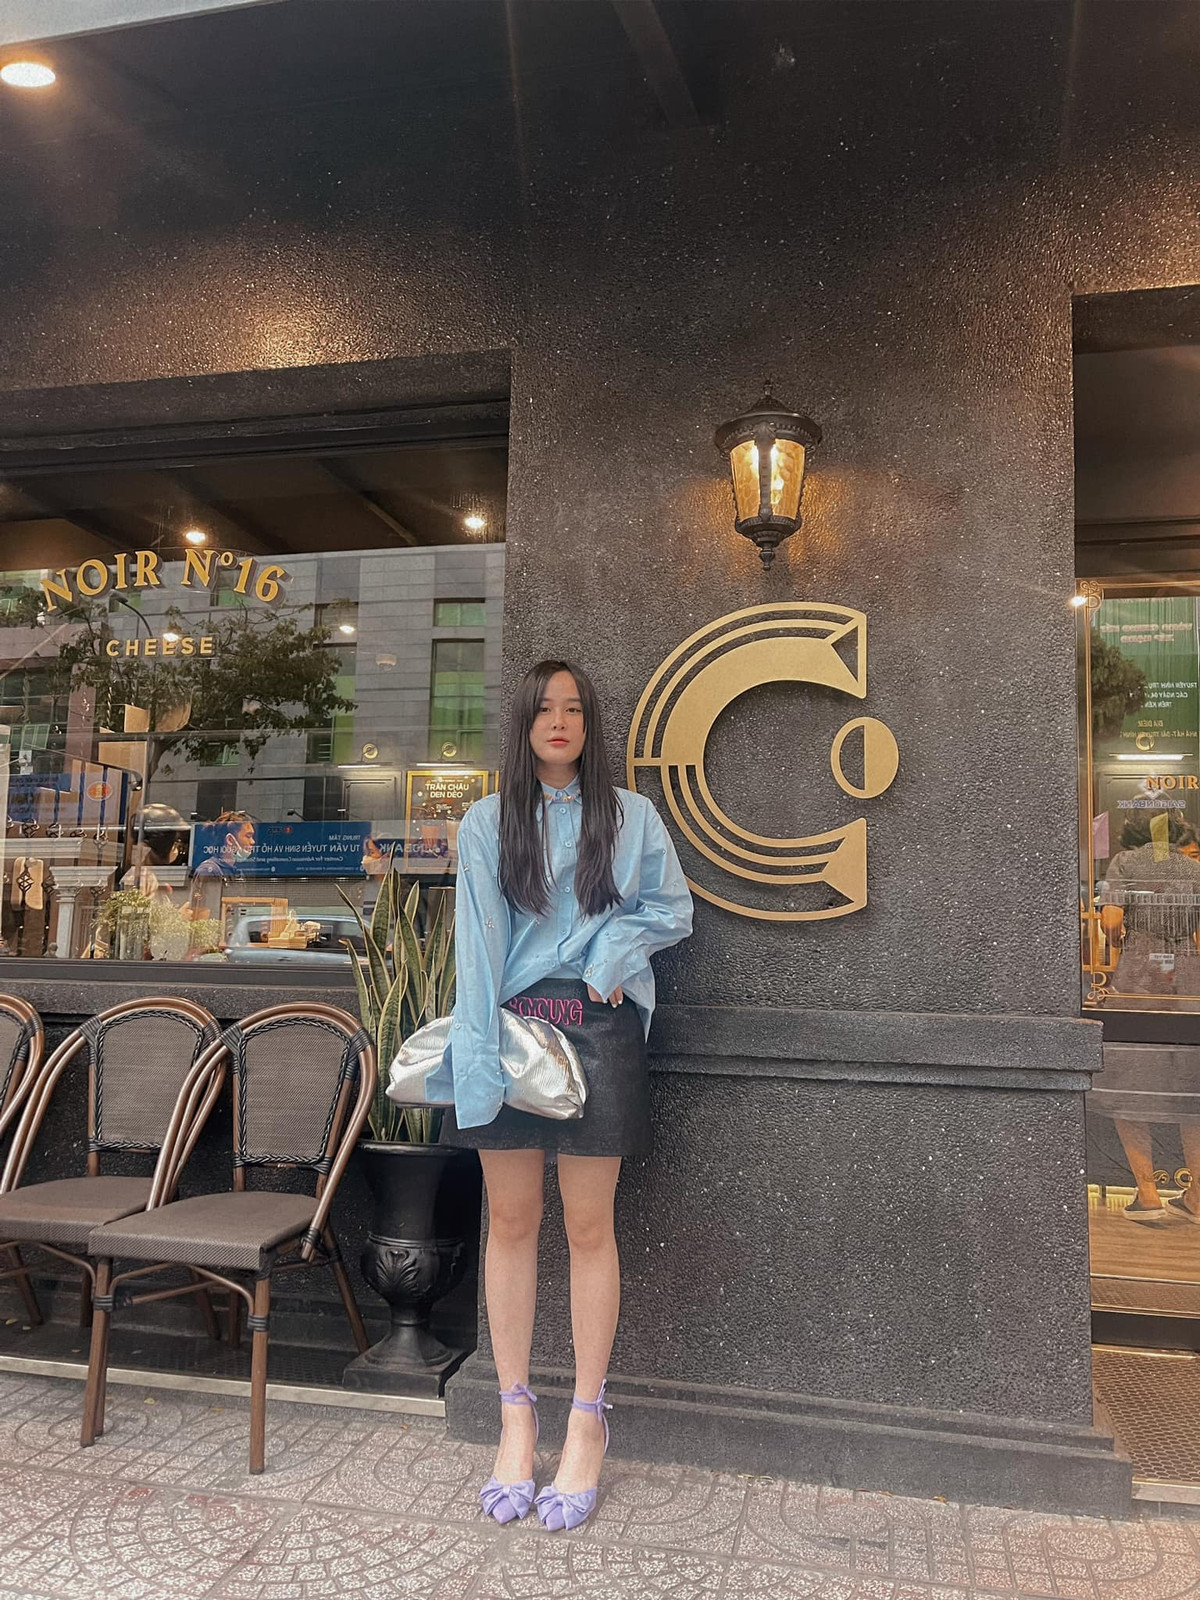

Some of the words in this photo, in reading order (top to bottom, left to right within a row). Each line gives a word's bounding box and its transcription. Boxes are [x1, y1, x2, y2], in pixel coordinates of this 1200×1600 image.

[40, 550, 161, 612] NOIR
[106, 636, 214, 657] CHEESE
[1147, 775, 1199, 790] NOIR
